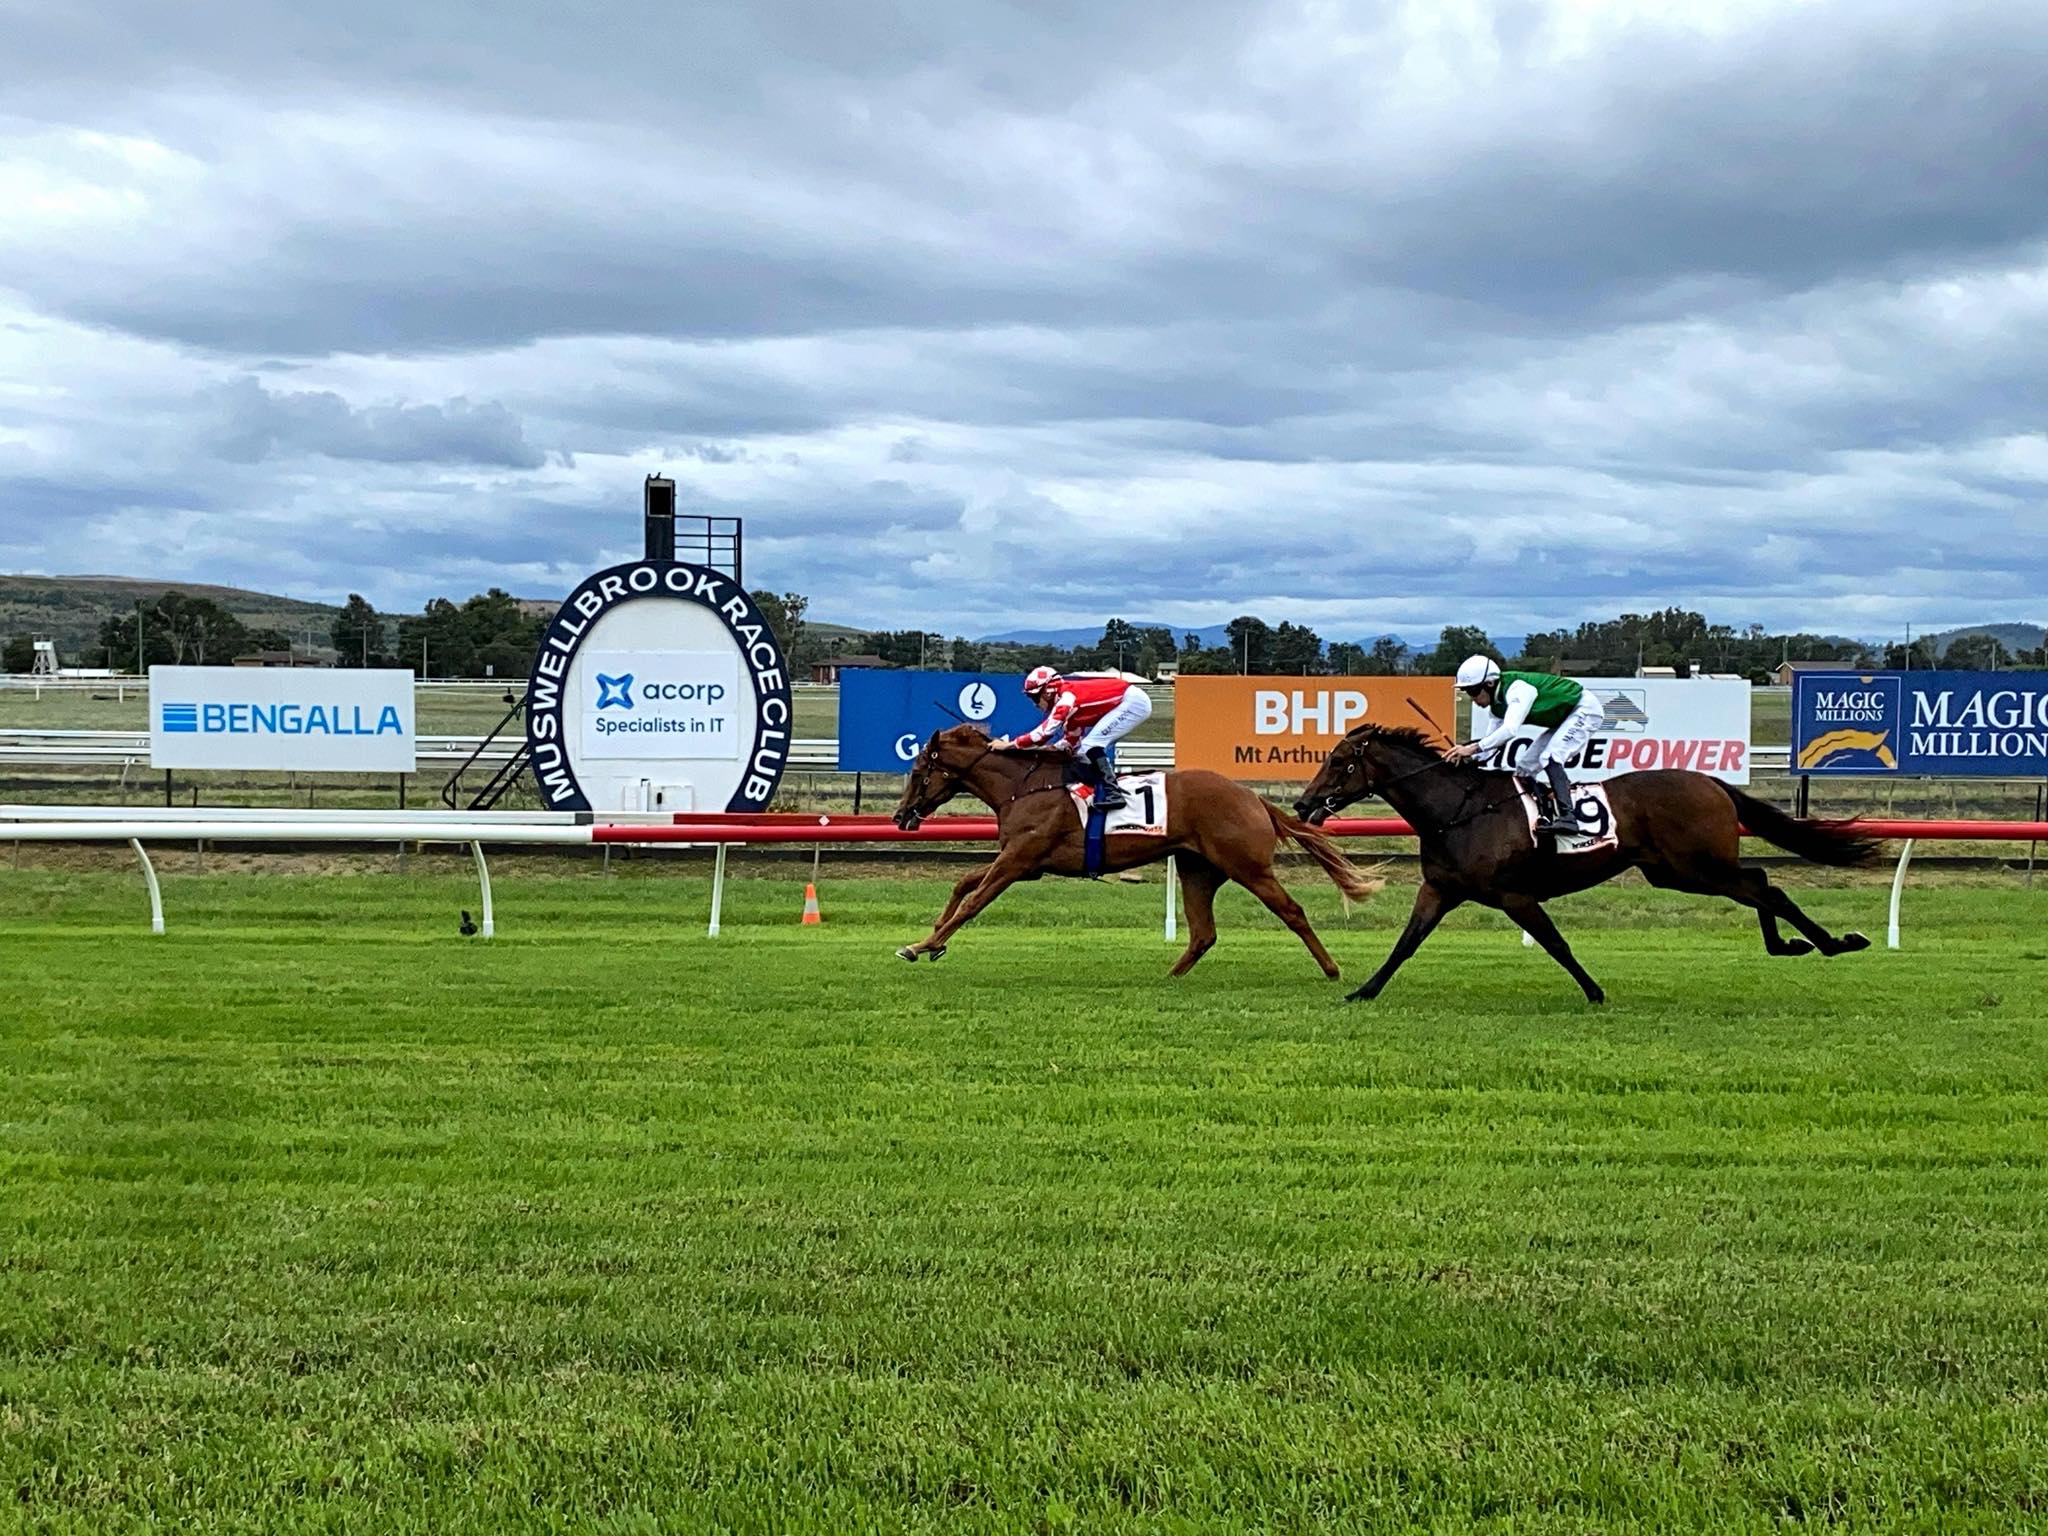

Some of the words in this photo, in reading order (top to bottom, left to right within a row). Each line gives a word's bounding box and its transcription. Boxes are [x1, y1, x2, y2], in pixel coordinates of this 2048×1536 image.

[721, 595, 784, 695] RACE
[532, 566, 724, 803] MUSWELLBROOK
[642, 683, 725, 706] acorp
[1815, 691, 1885, 710] MAGIC
[203, 703, 403, 736] BENGALLA
[595, 717, 686, 736] Specialists
[690, 717, 705, 733] in
[710, 717, 725, 733] IT
[1254, 690, 1369, 736] BHP
[1815, 709, 1885, 723] MILLIONS
[744, 697, 788, 803] CLUB
[1234, 745, 1263, 764] Mt
[1267, 744, 1331, 764] Arthu
[1134, 785, 1155, 825] 1
[1574, 795, 1609, 837] 9
